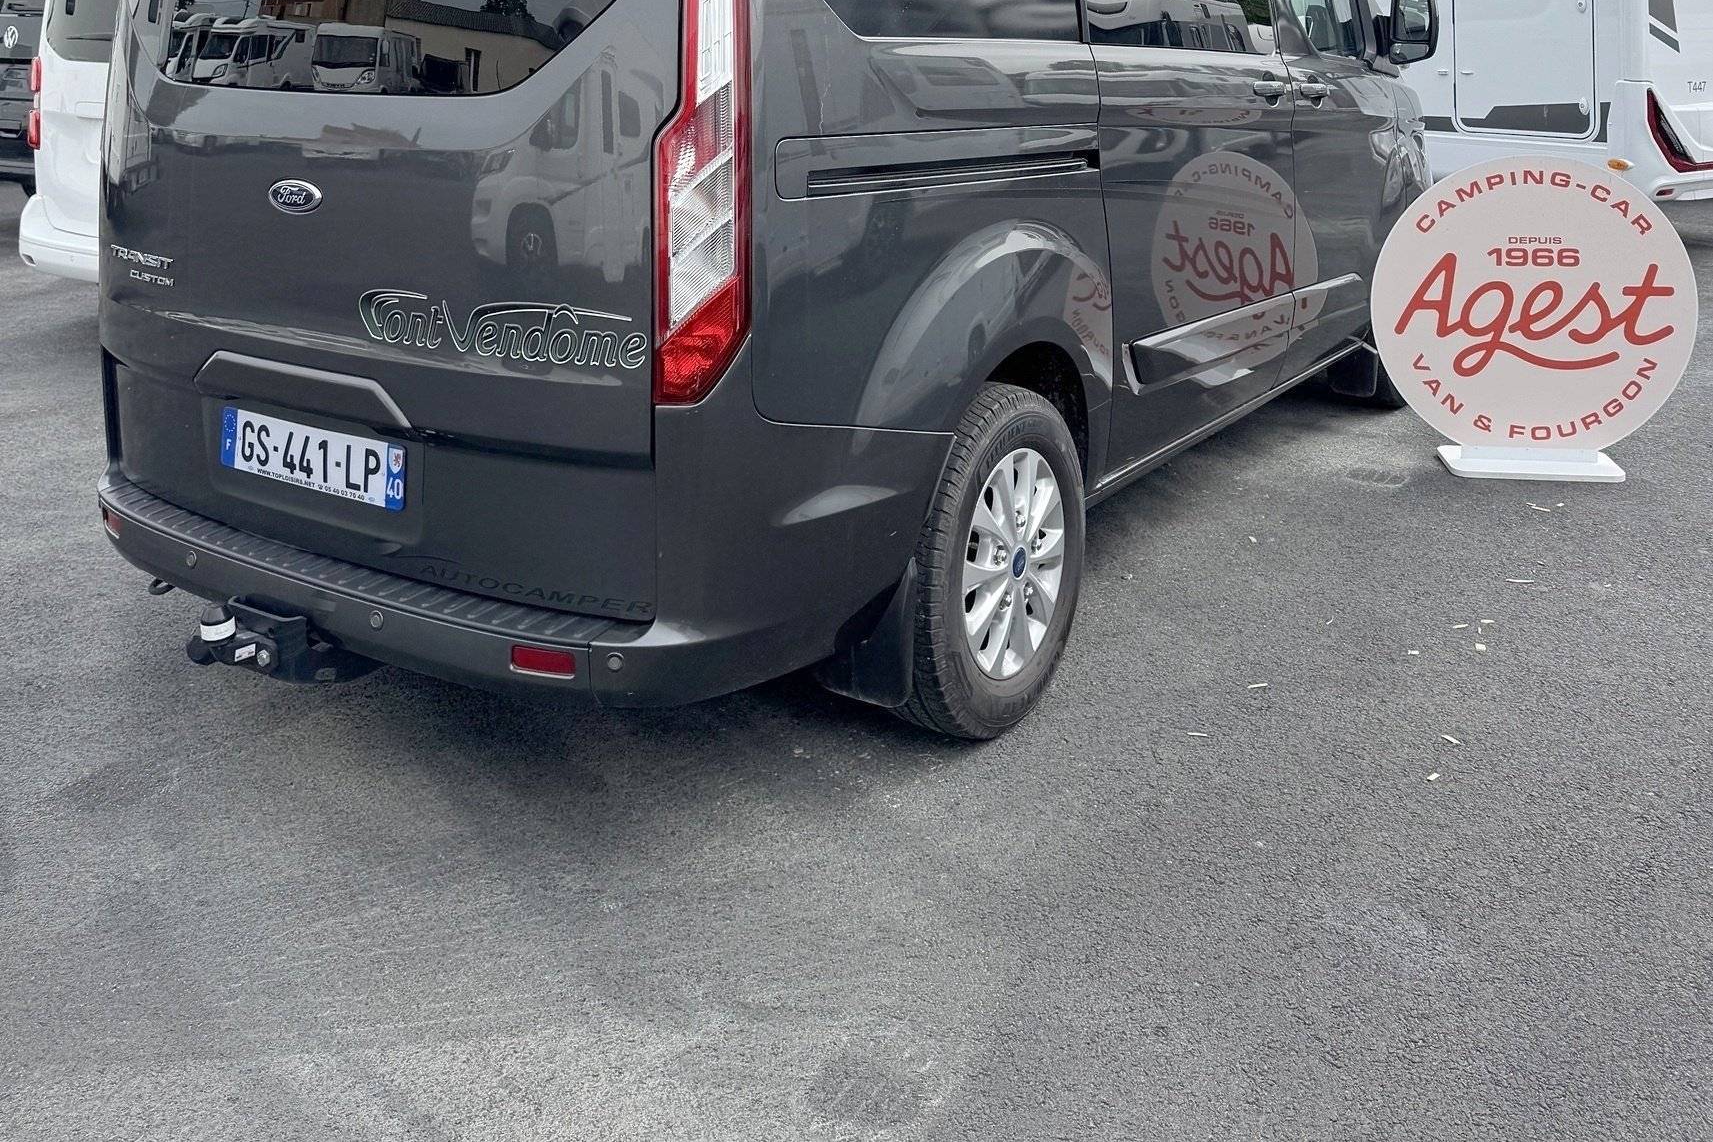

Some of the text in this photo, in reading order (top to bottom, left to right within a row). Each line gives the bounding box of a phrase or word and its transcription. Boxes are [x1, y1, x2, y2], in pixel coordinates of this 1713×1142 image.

[1687, 80, 1707, 94] T447
[277, 185, 307, 205] Ford
[1415, 169, 1653, 236] CAMPING-CAR
[1508, 236, 1563, 245] DEPUIS
[110, 244, 175, 269] TRANSIT
[1486, 247, 1581, 267] 1966
[129, 269, 176, 287] CUSTOM
[1393, 252, 1675, 378] Agest
[1412, 353, 1660, 441] VAN & FOURGON
[226, 438, 232, 450] F
[241, 420, 381, 493] GS-441-LP
[257, 468, 316, 488] WWW.TOPLOISIRS.NET
[386, 478, 404, 499] 40
[419, 564, 653, 614] AUTOCAMPER
